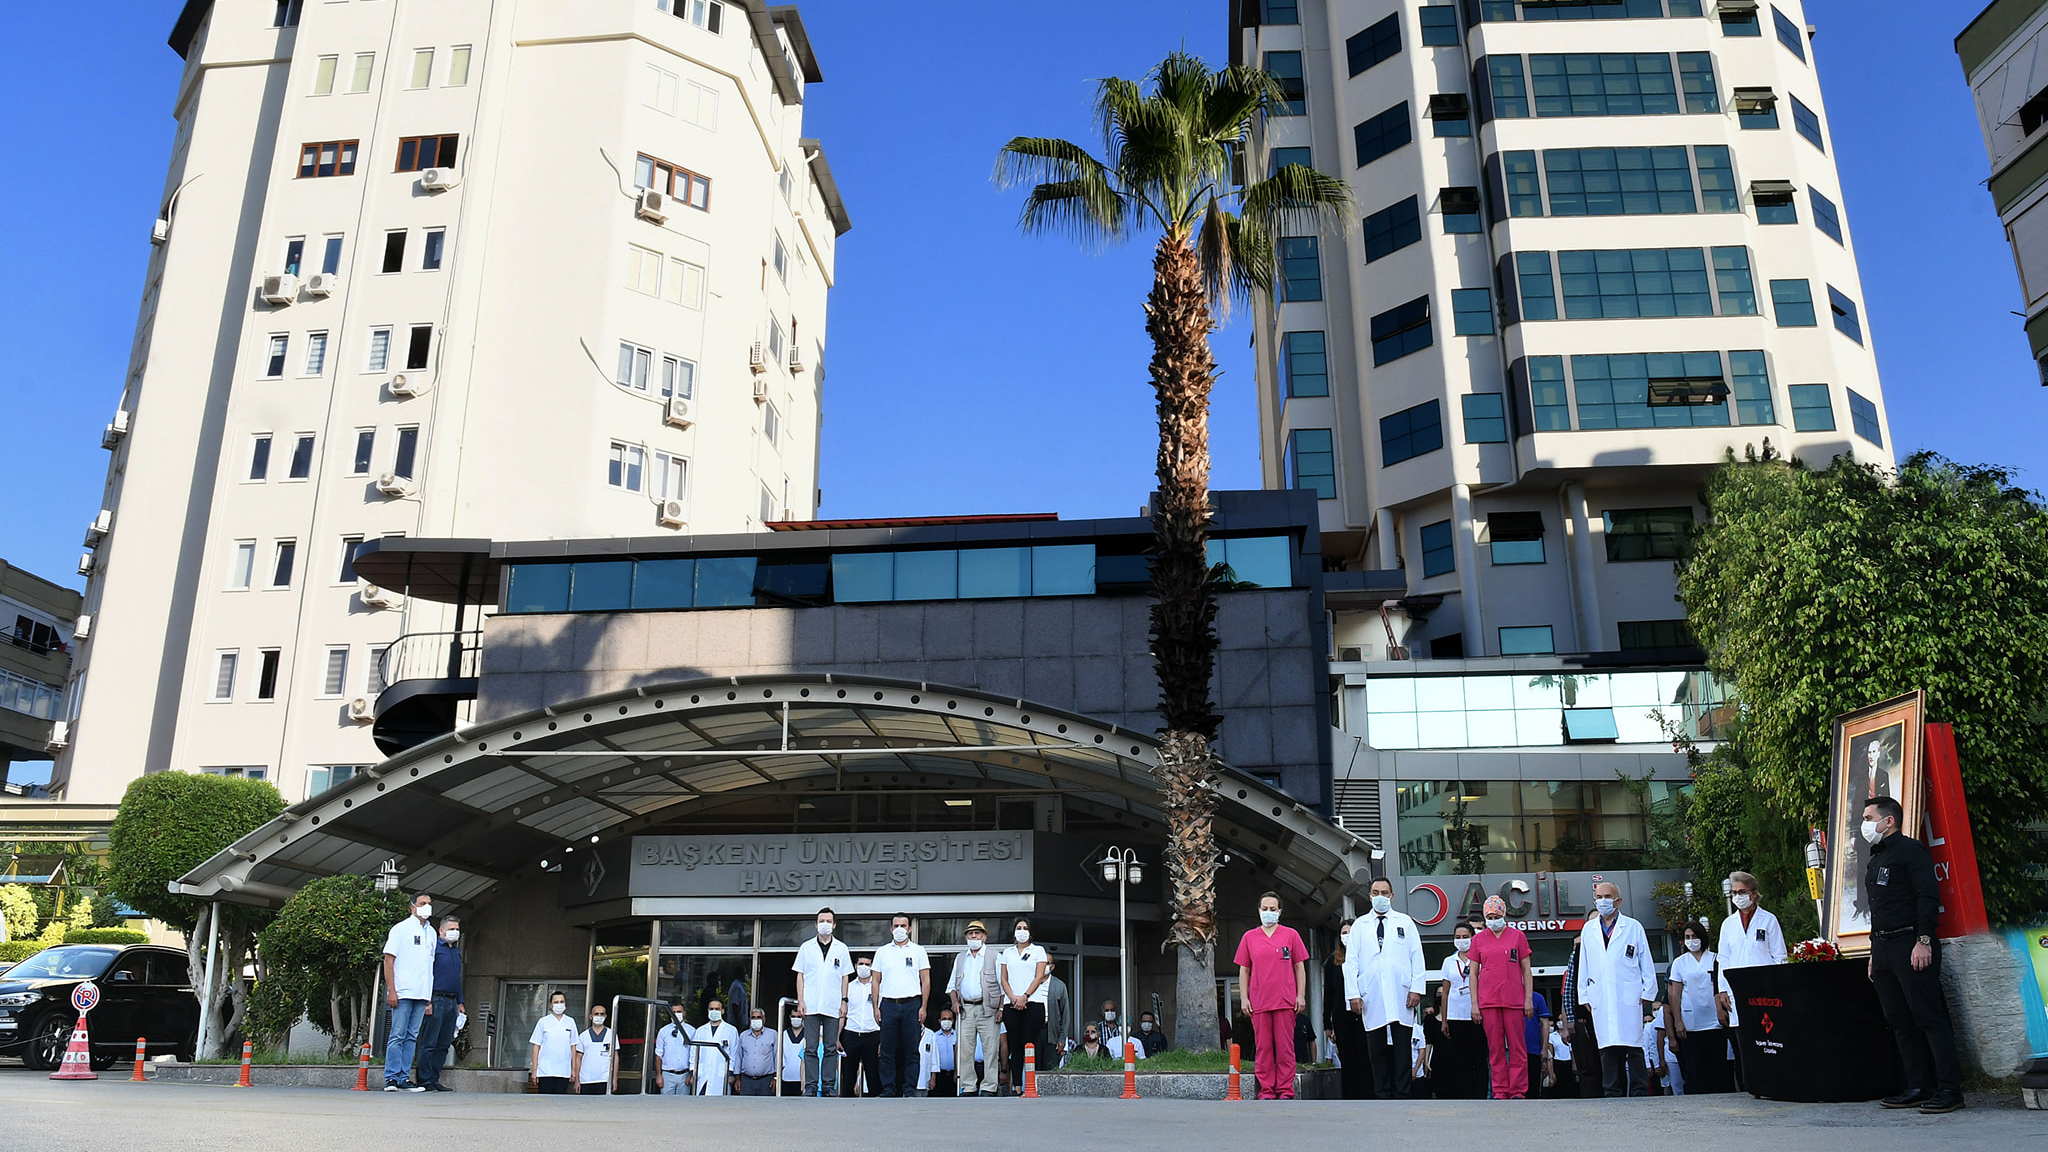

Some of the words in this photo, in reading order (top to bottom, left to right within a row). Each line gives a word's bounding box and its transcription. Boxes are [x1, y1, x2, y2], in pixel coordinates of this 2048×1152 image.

[639, 841, 787, 871] BAŞKENT
[799, 833, 1024, 865] ÜNİVERSİTESİ
[738, 866, 919, 894] HASTANESİ
[1457, 870, 1586, 918] ACİL
[1506, 920, 1566, 931] RGENCY
